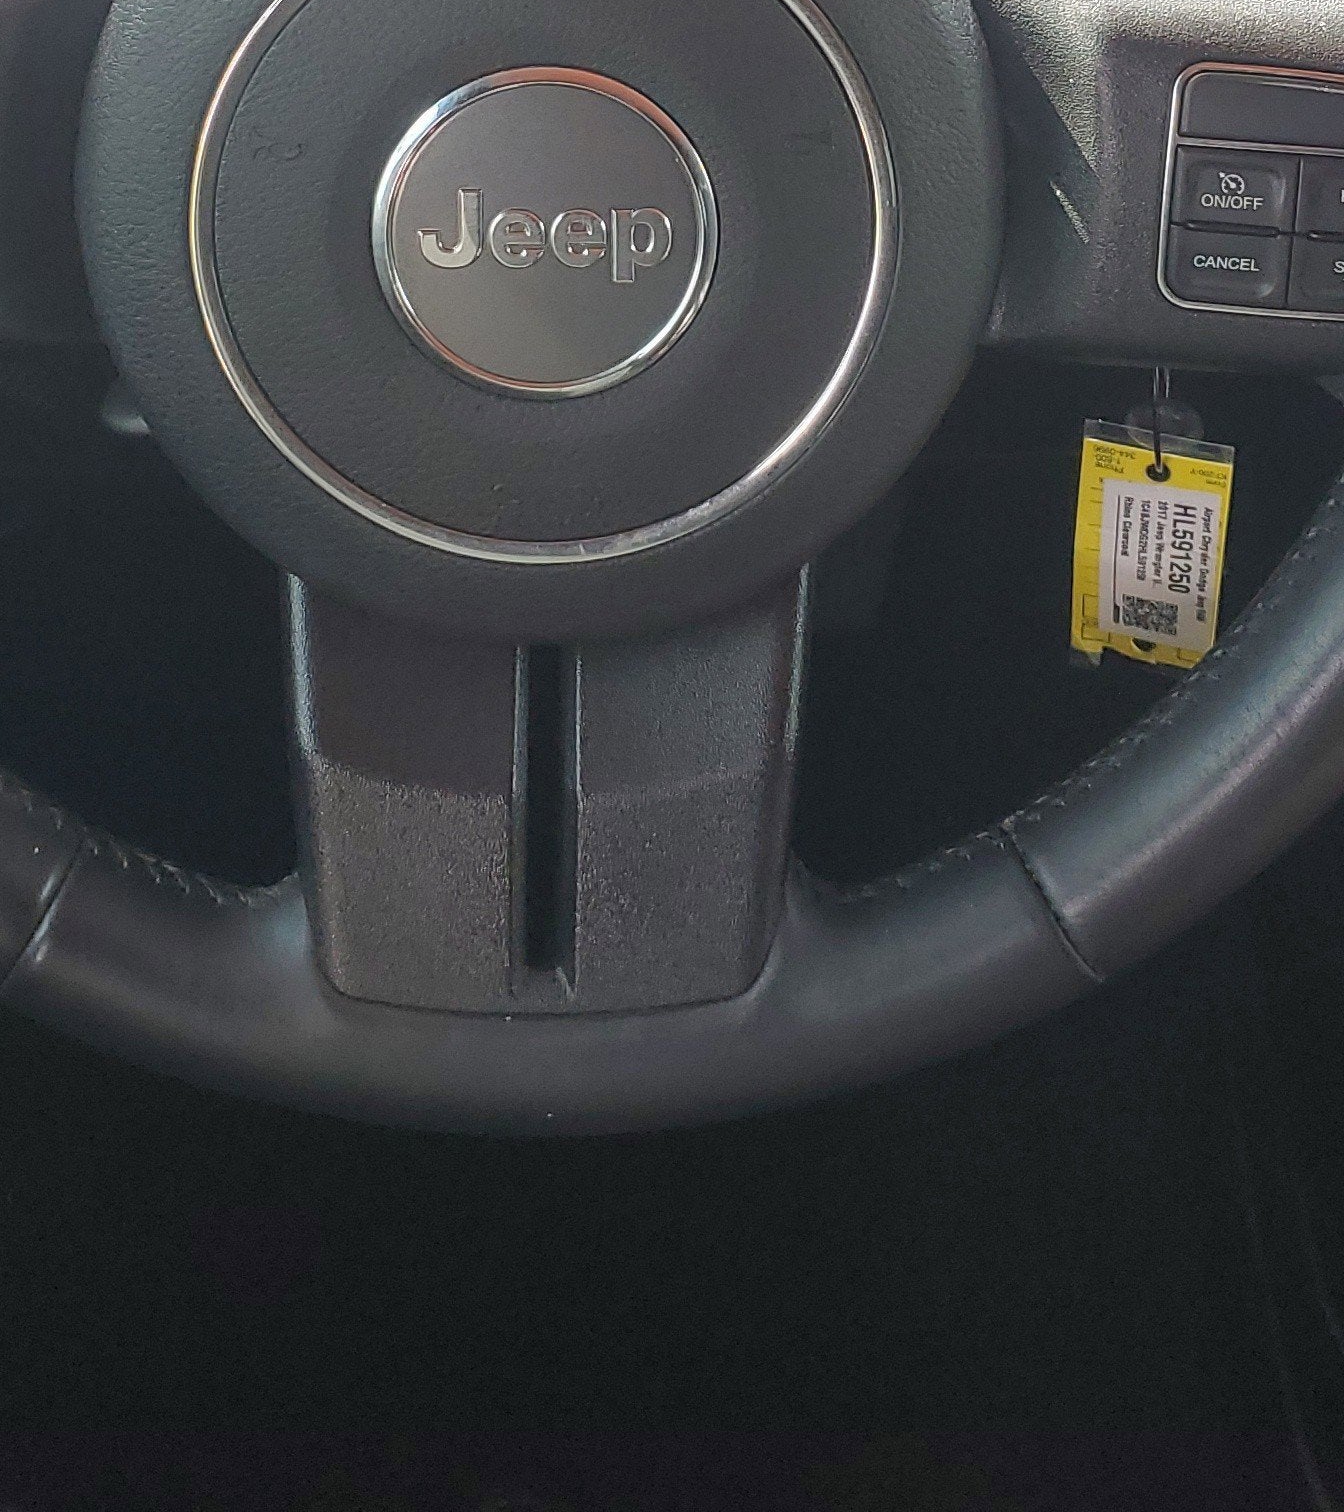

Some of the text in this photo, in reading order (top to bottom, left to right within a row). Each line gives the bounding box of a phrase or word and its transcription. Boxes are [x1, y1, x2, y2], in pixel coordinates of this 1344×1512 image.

[1201, 193, 1264, 211] ON/OFF
[417, 188, 673, 283] Jeep
[1193, 254, 1261, 273] CANCEL
[1167, 503, 1198, 594] HL591250
